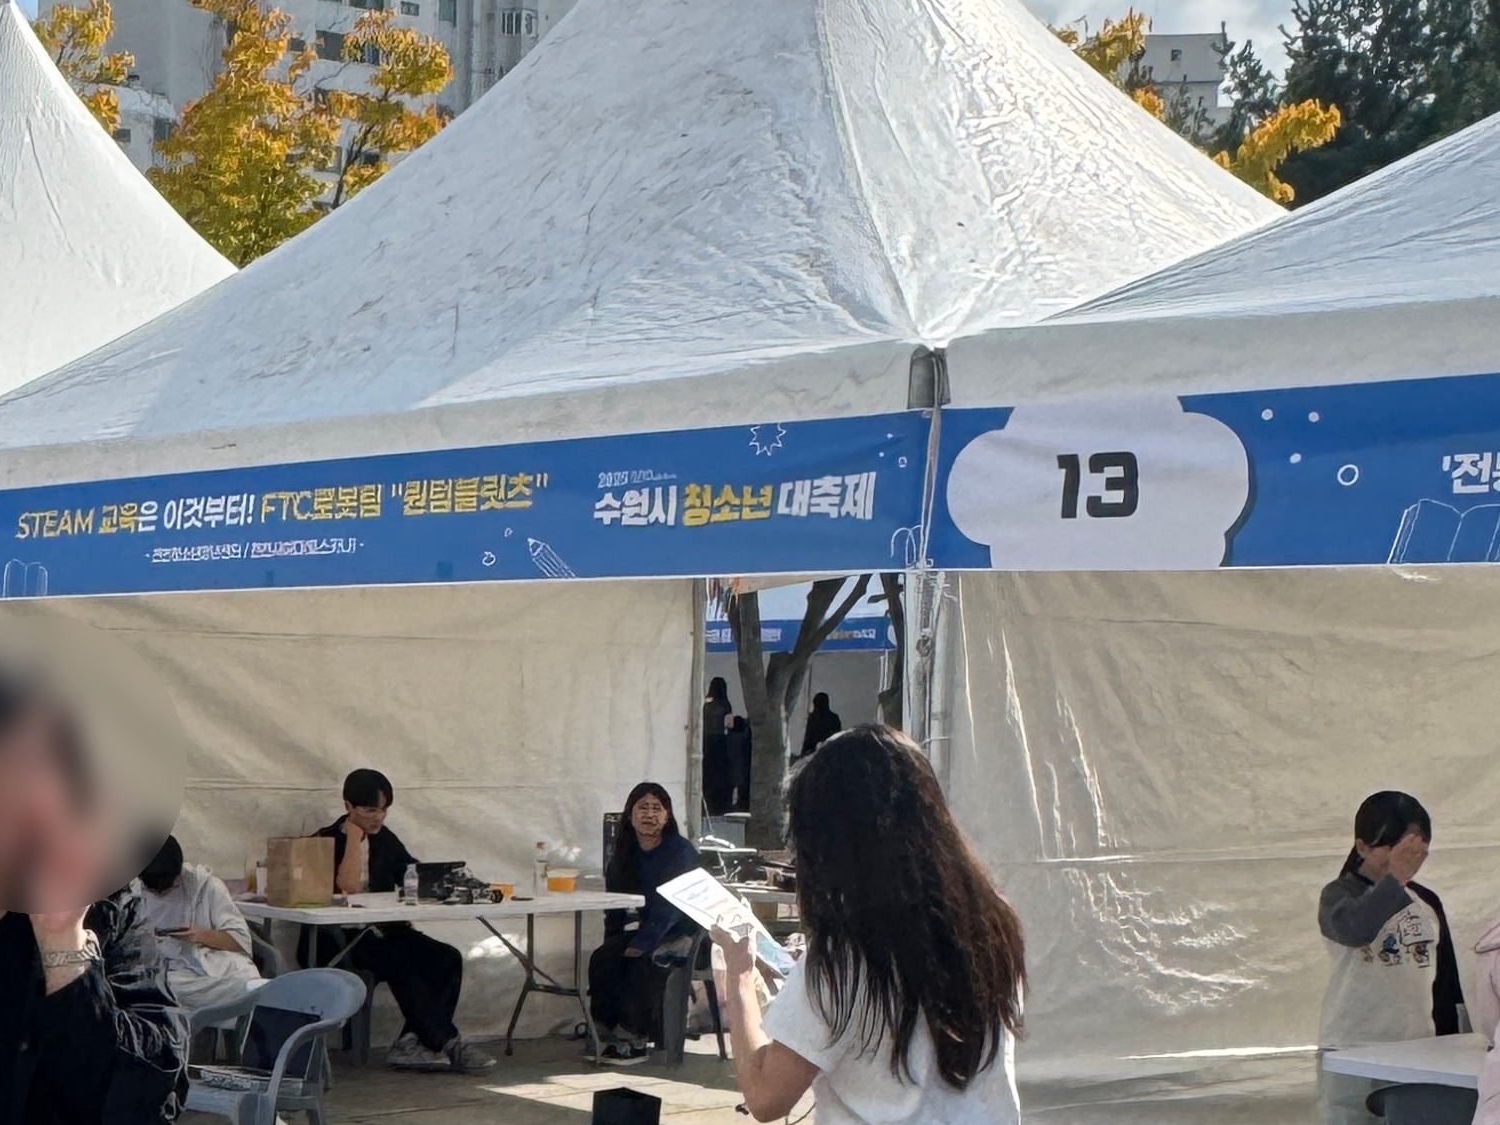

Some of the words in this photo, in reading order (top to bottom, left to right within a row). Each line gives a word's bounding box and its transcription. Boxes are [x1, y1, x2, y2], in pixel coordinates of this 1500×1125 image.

[593, 485, 677, 526] 수원시
[682, 483, 774, 527] 청소년
[777, 472, 877, 520] 대축제
[1056, 450, 1140, 520] 13
[1442, 452, 1500, 495] '전
[16, 507, 95, 539] STEAM
[99, 501, 159, 534] 교육은
[164, 493, 256, 530] 이것부터!
[261, 483, 382, 523] FTC로봇팀
